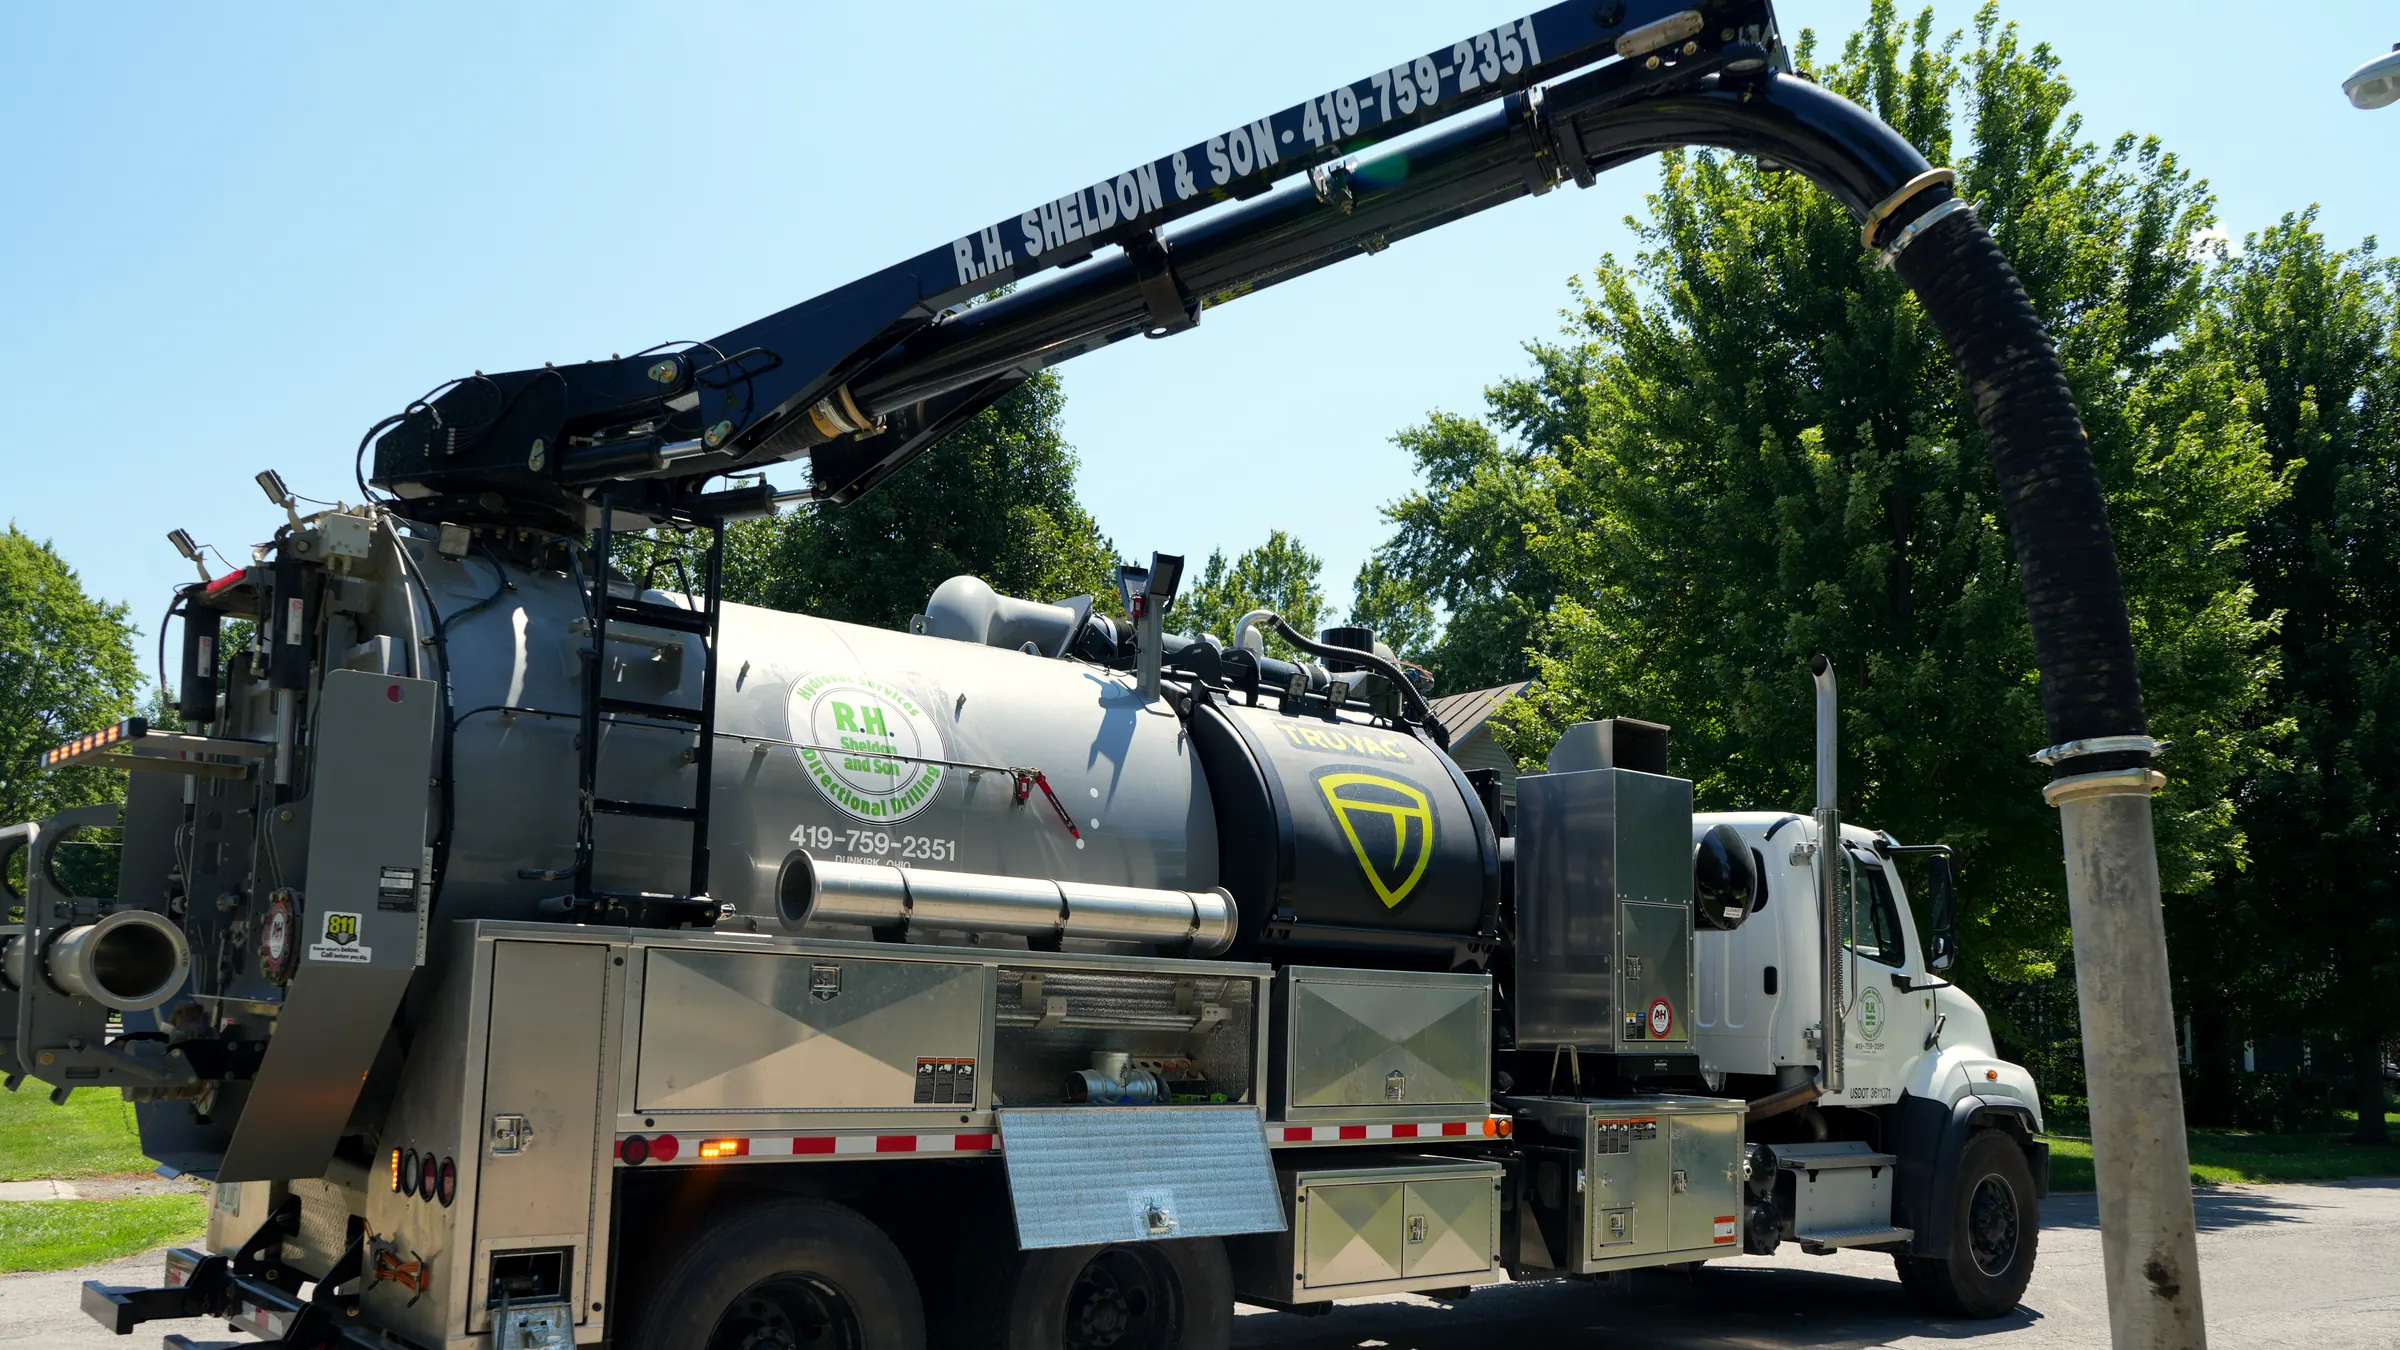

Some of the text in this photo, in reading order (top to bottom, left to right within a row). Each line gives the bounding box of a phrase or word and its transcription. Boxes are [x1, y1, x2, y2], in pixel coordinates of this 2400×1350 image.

[953, 15, 1541, 286] R.H. SHELDON & SON 419-759-2351
[858, 675, 919, 717] Services
[831, 701, 895, 738] R.H.
[840, 736, 898, 756] Sheldon
[1276, 723, 1407, 759] TRUVAC
[800, 748, 941, 817] Directional Drilling
[844, 757, 900, 776] and Son
[789, 824, 955, 862] 419-759-2351
[328, 914, 356, 935] 811
[1850, 1087, 1869, 1099] USDOT
